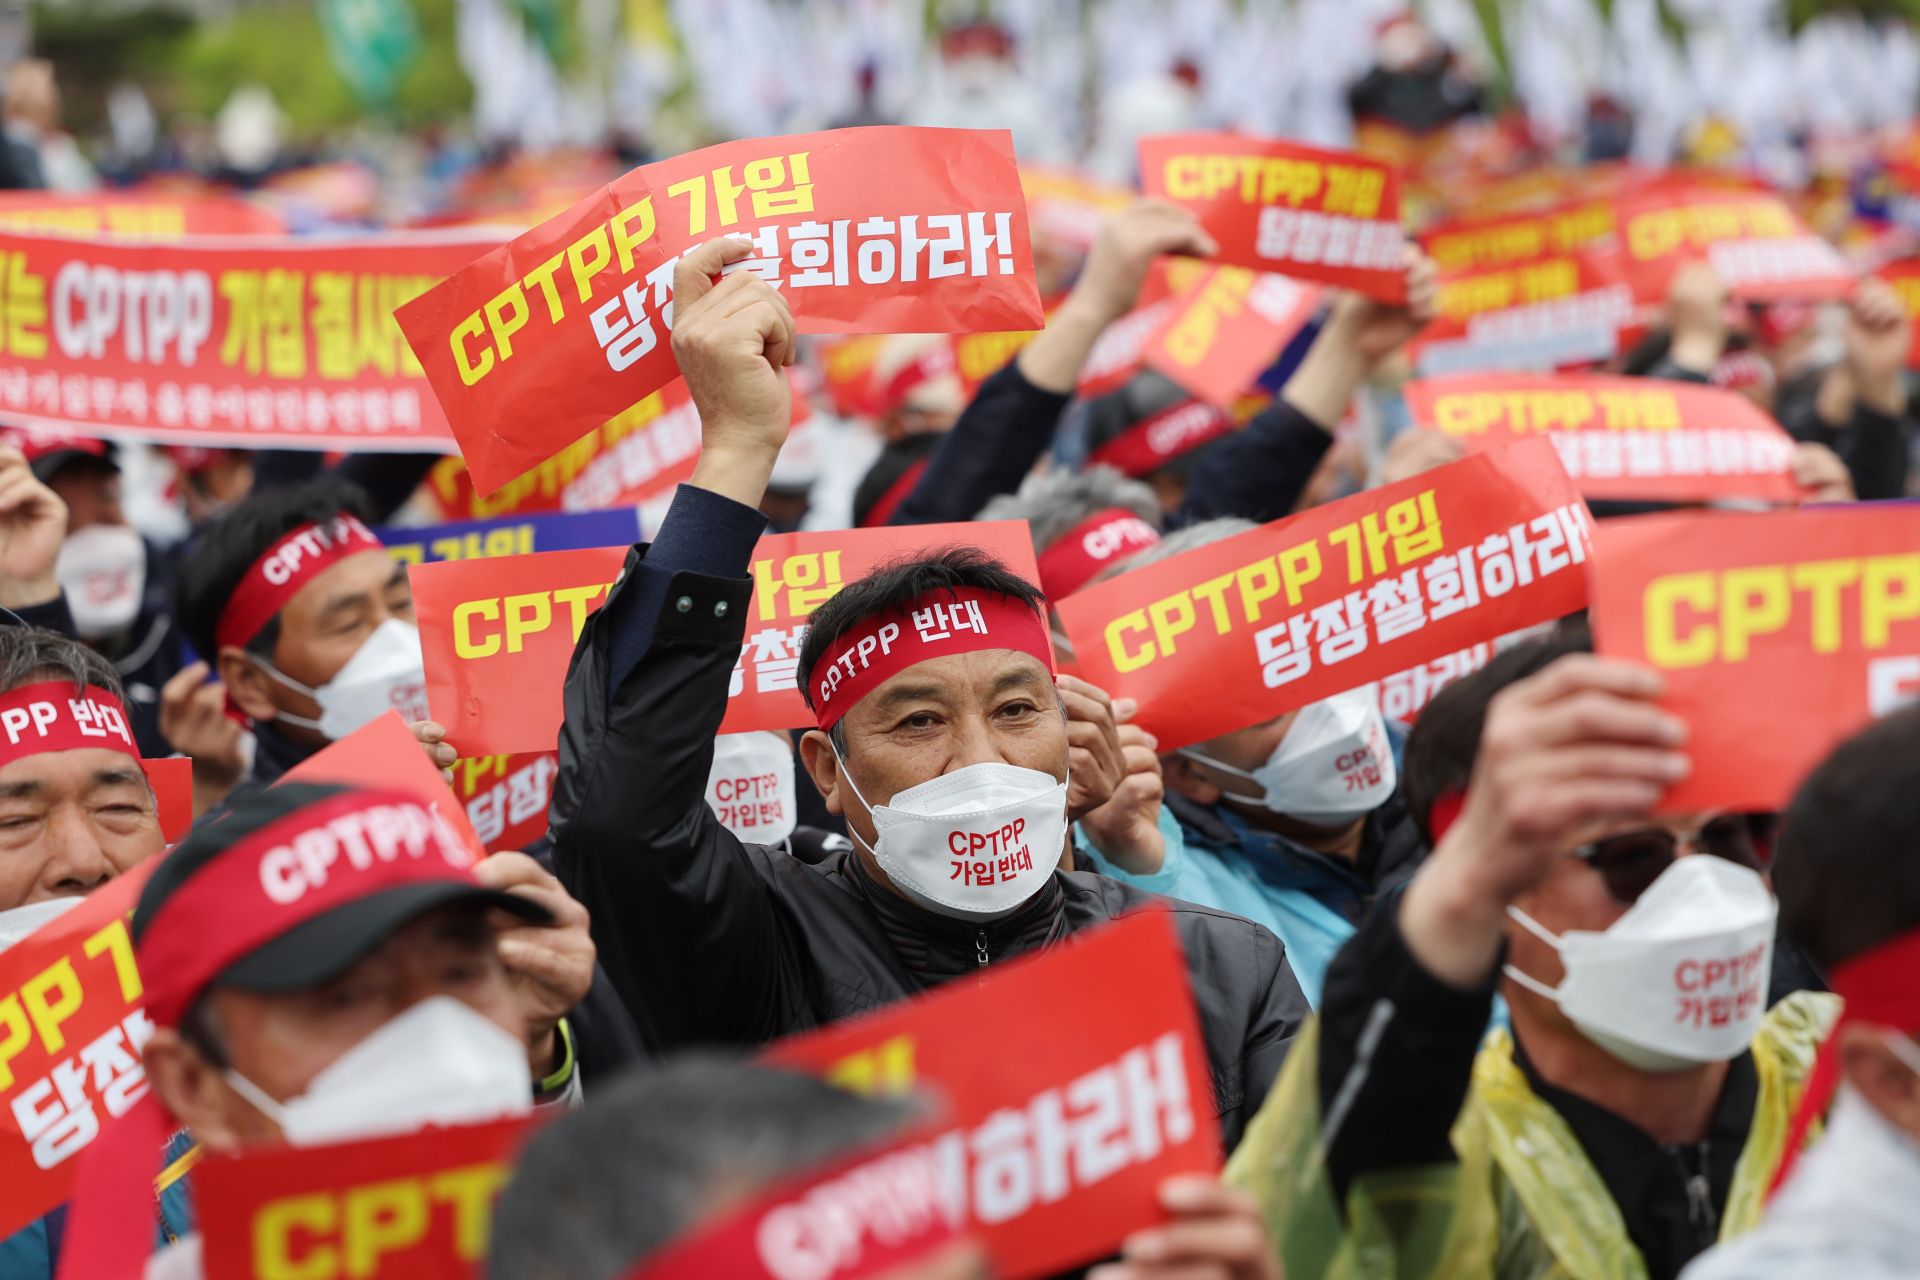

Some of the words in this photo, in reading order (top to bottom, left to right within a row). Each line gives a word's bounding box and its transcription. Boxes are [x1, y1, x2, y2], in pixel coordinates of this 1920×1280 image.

[1165, 154, 1322, 209] CPTPP
[449, 195, 657, 388] CPTPP
[667, 151, 816, 237] 가입
[53, 259, 214, 368] CPTPP
[219, 267, 305, 378] 가입
[1434, 389, 1594, 434] CPTPP
[1104, 540, 1322, 673] CPTPP
[1329, 489, 1444, 585] 가입
[453, 583, 615, 660] CPT
[820, 622, 900, 702] CPTPP
[911, 599, 988, 643] 반대
[67, 698, 132, 746] 반대
[715, 773, 778, 802] CPTPP
[259, 803, 431, 905] CPTPP
[948, 817, 1026, 858] CPTPP
[949, 844, 1034, 887] 가입반대
